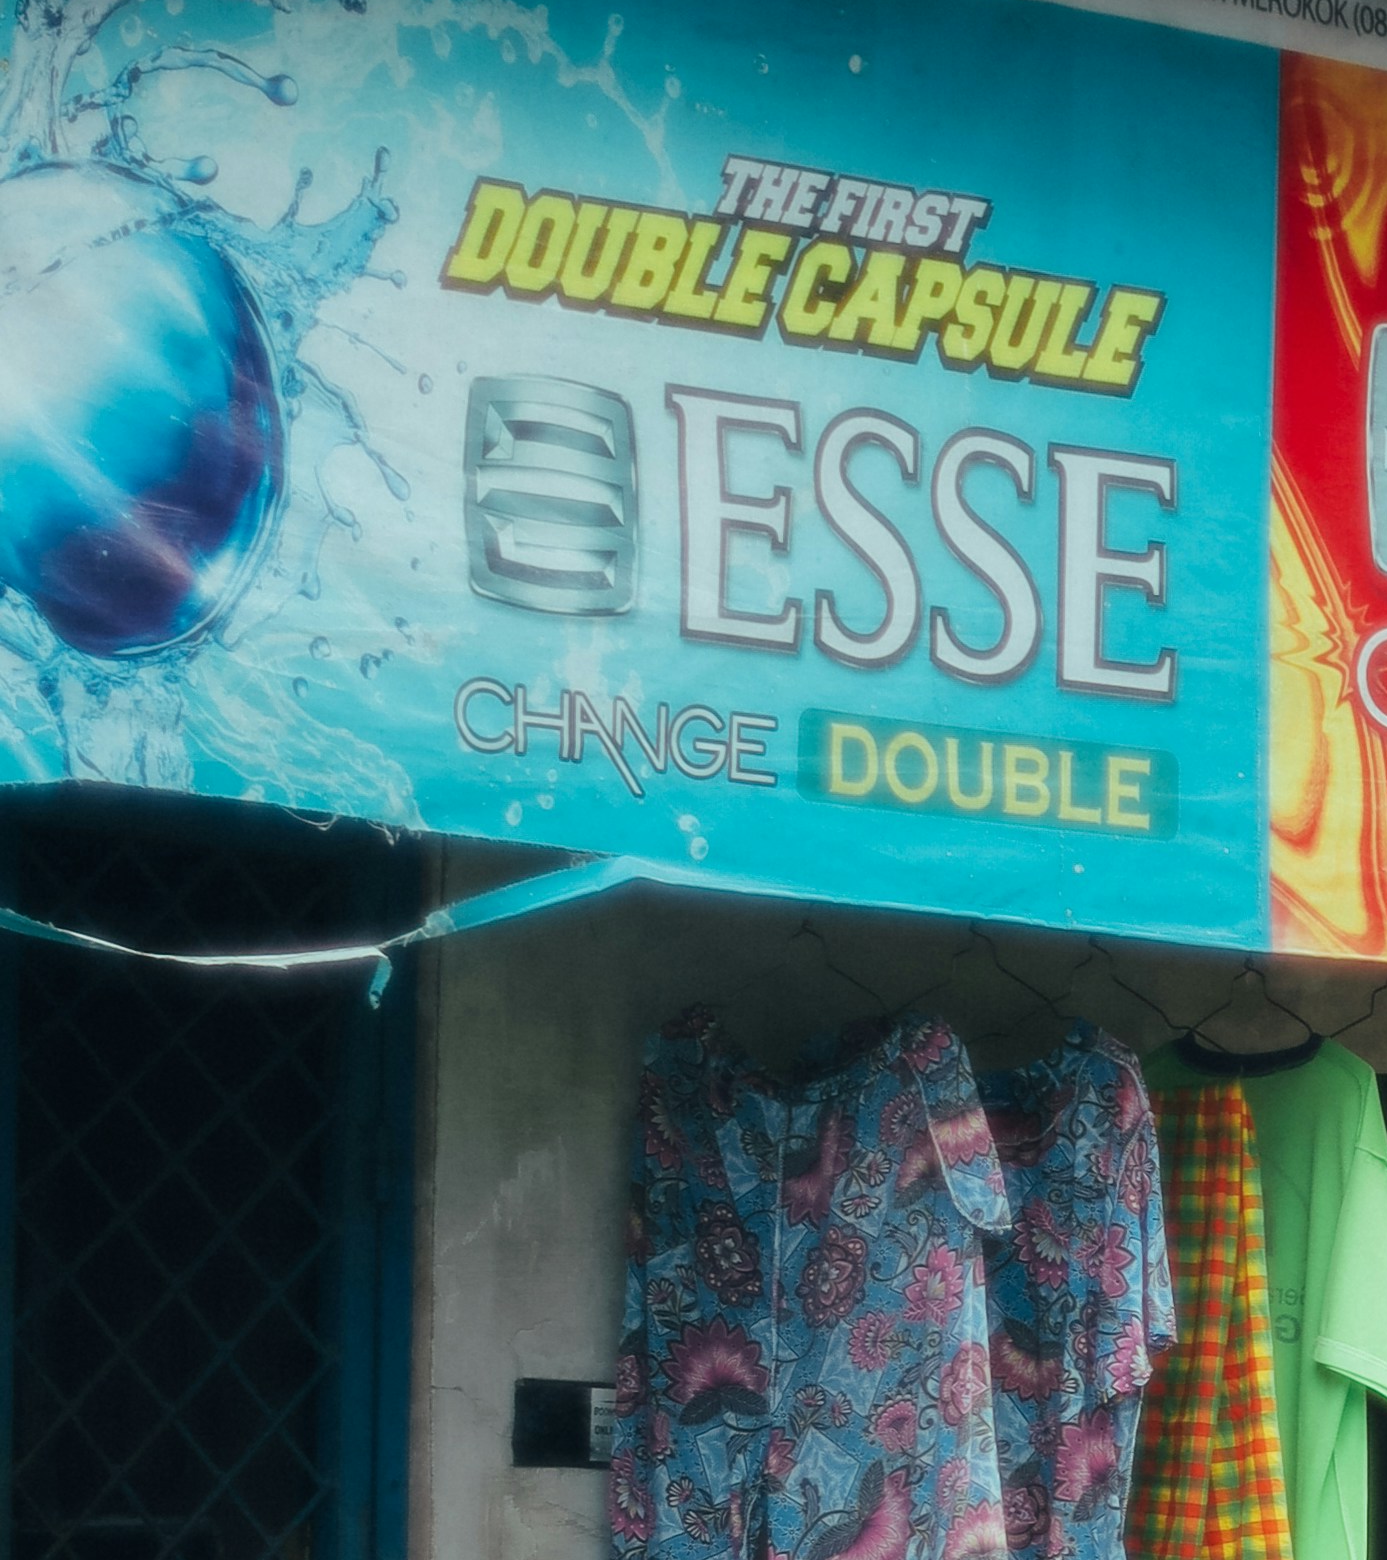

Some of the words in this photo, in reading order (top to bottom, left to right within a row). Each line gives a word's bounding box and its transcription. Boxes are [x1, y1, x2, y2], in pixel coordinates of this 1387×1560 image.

[444, 180, 793, 330] DOUBLE
[781, 236, 1162, 389] CAPSULE
[716, 155, 821, 227] THE
[822, 174, 987, 252] FIRST
[666, 383, 1178, 703] ESSE
[453, 675, 779, 797] CHANGE
[829, 723, 1151, 829] DOUBLE
